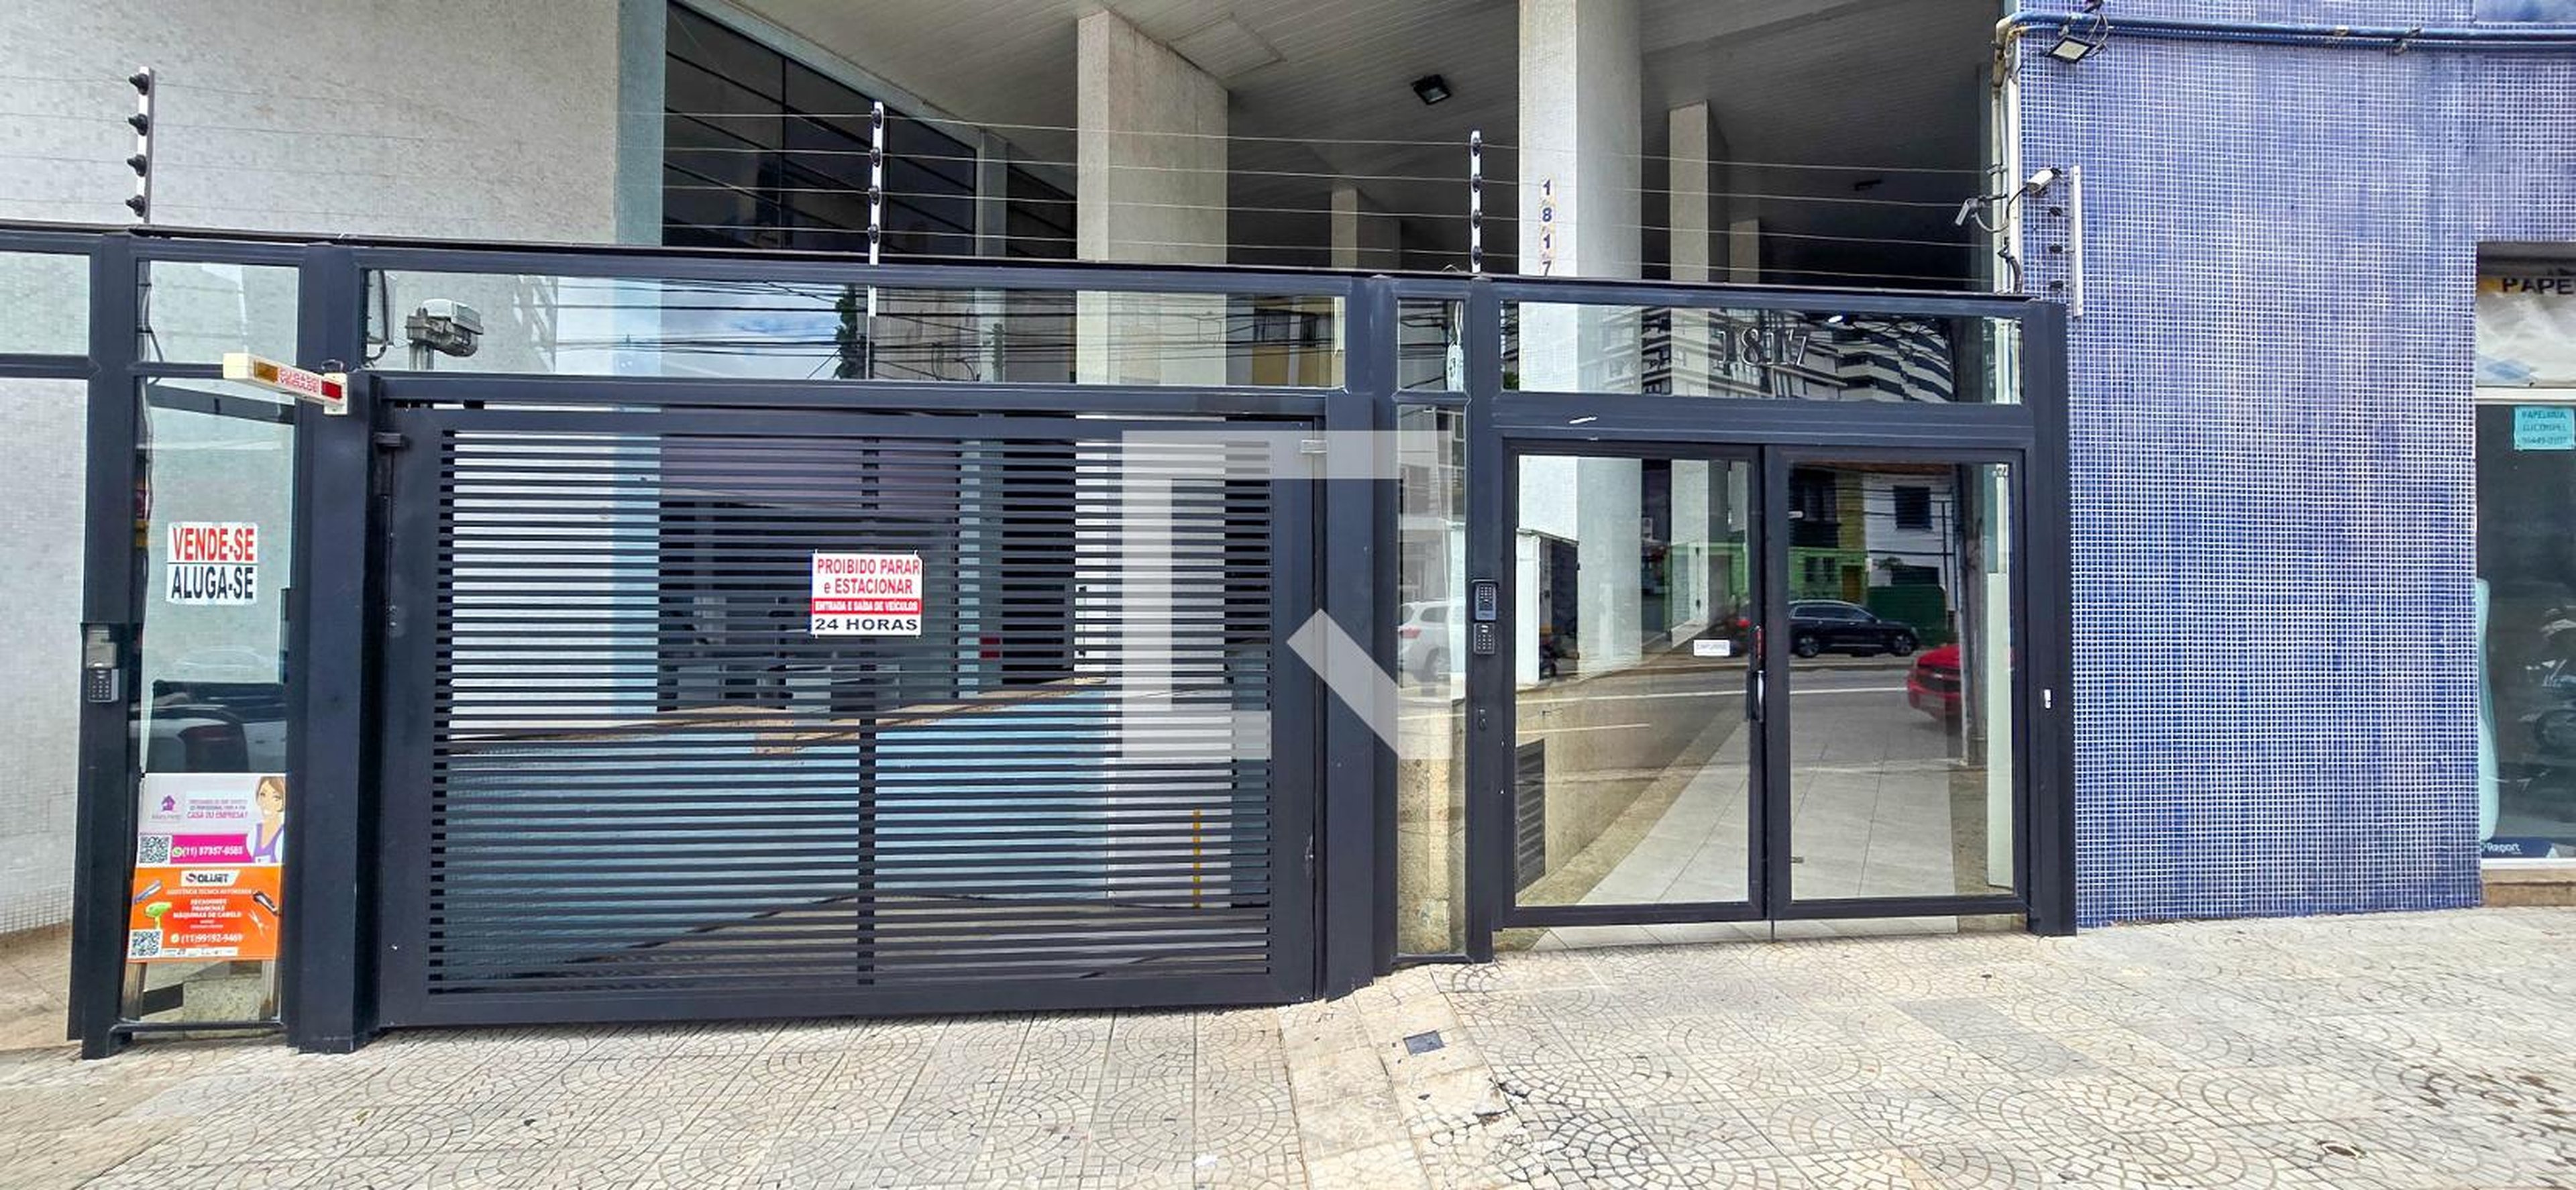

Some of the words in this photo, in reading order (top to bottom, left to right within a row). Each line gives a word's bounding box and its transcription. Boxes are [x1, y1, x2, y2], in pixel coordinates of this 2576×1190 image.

[1542, 179, 1552, 276] 1817
[1719, 327, 1807, 367] 1817
[173, 528, 254, 561] VENDE-SE
[817, 559, 876, 574] PROIBIDO
[880, 559, 920, 574] PARAR
[171, 566, 254, 599] ALUGA-SE
[824, 582, 831, 594] e
[835, 578, 913, 594] ESTACIONAR
[814, 601, 847, 611] ENTRADA
[847, 601, 853, 611] E
[874, 601, 884, 611] DE
[815, 618, 839, 630] 24
[846, 618, 918, 631] HORAS
[187, 811, 203, 819] CASA
[205, 811, 214, 819] OU
[182, 846, 198, 857] (11)
